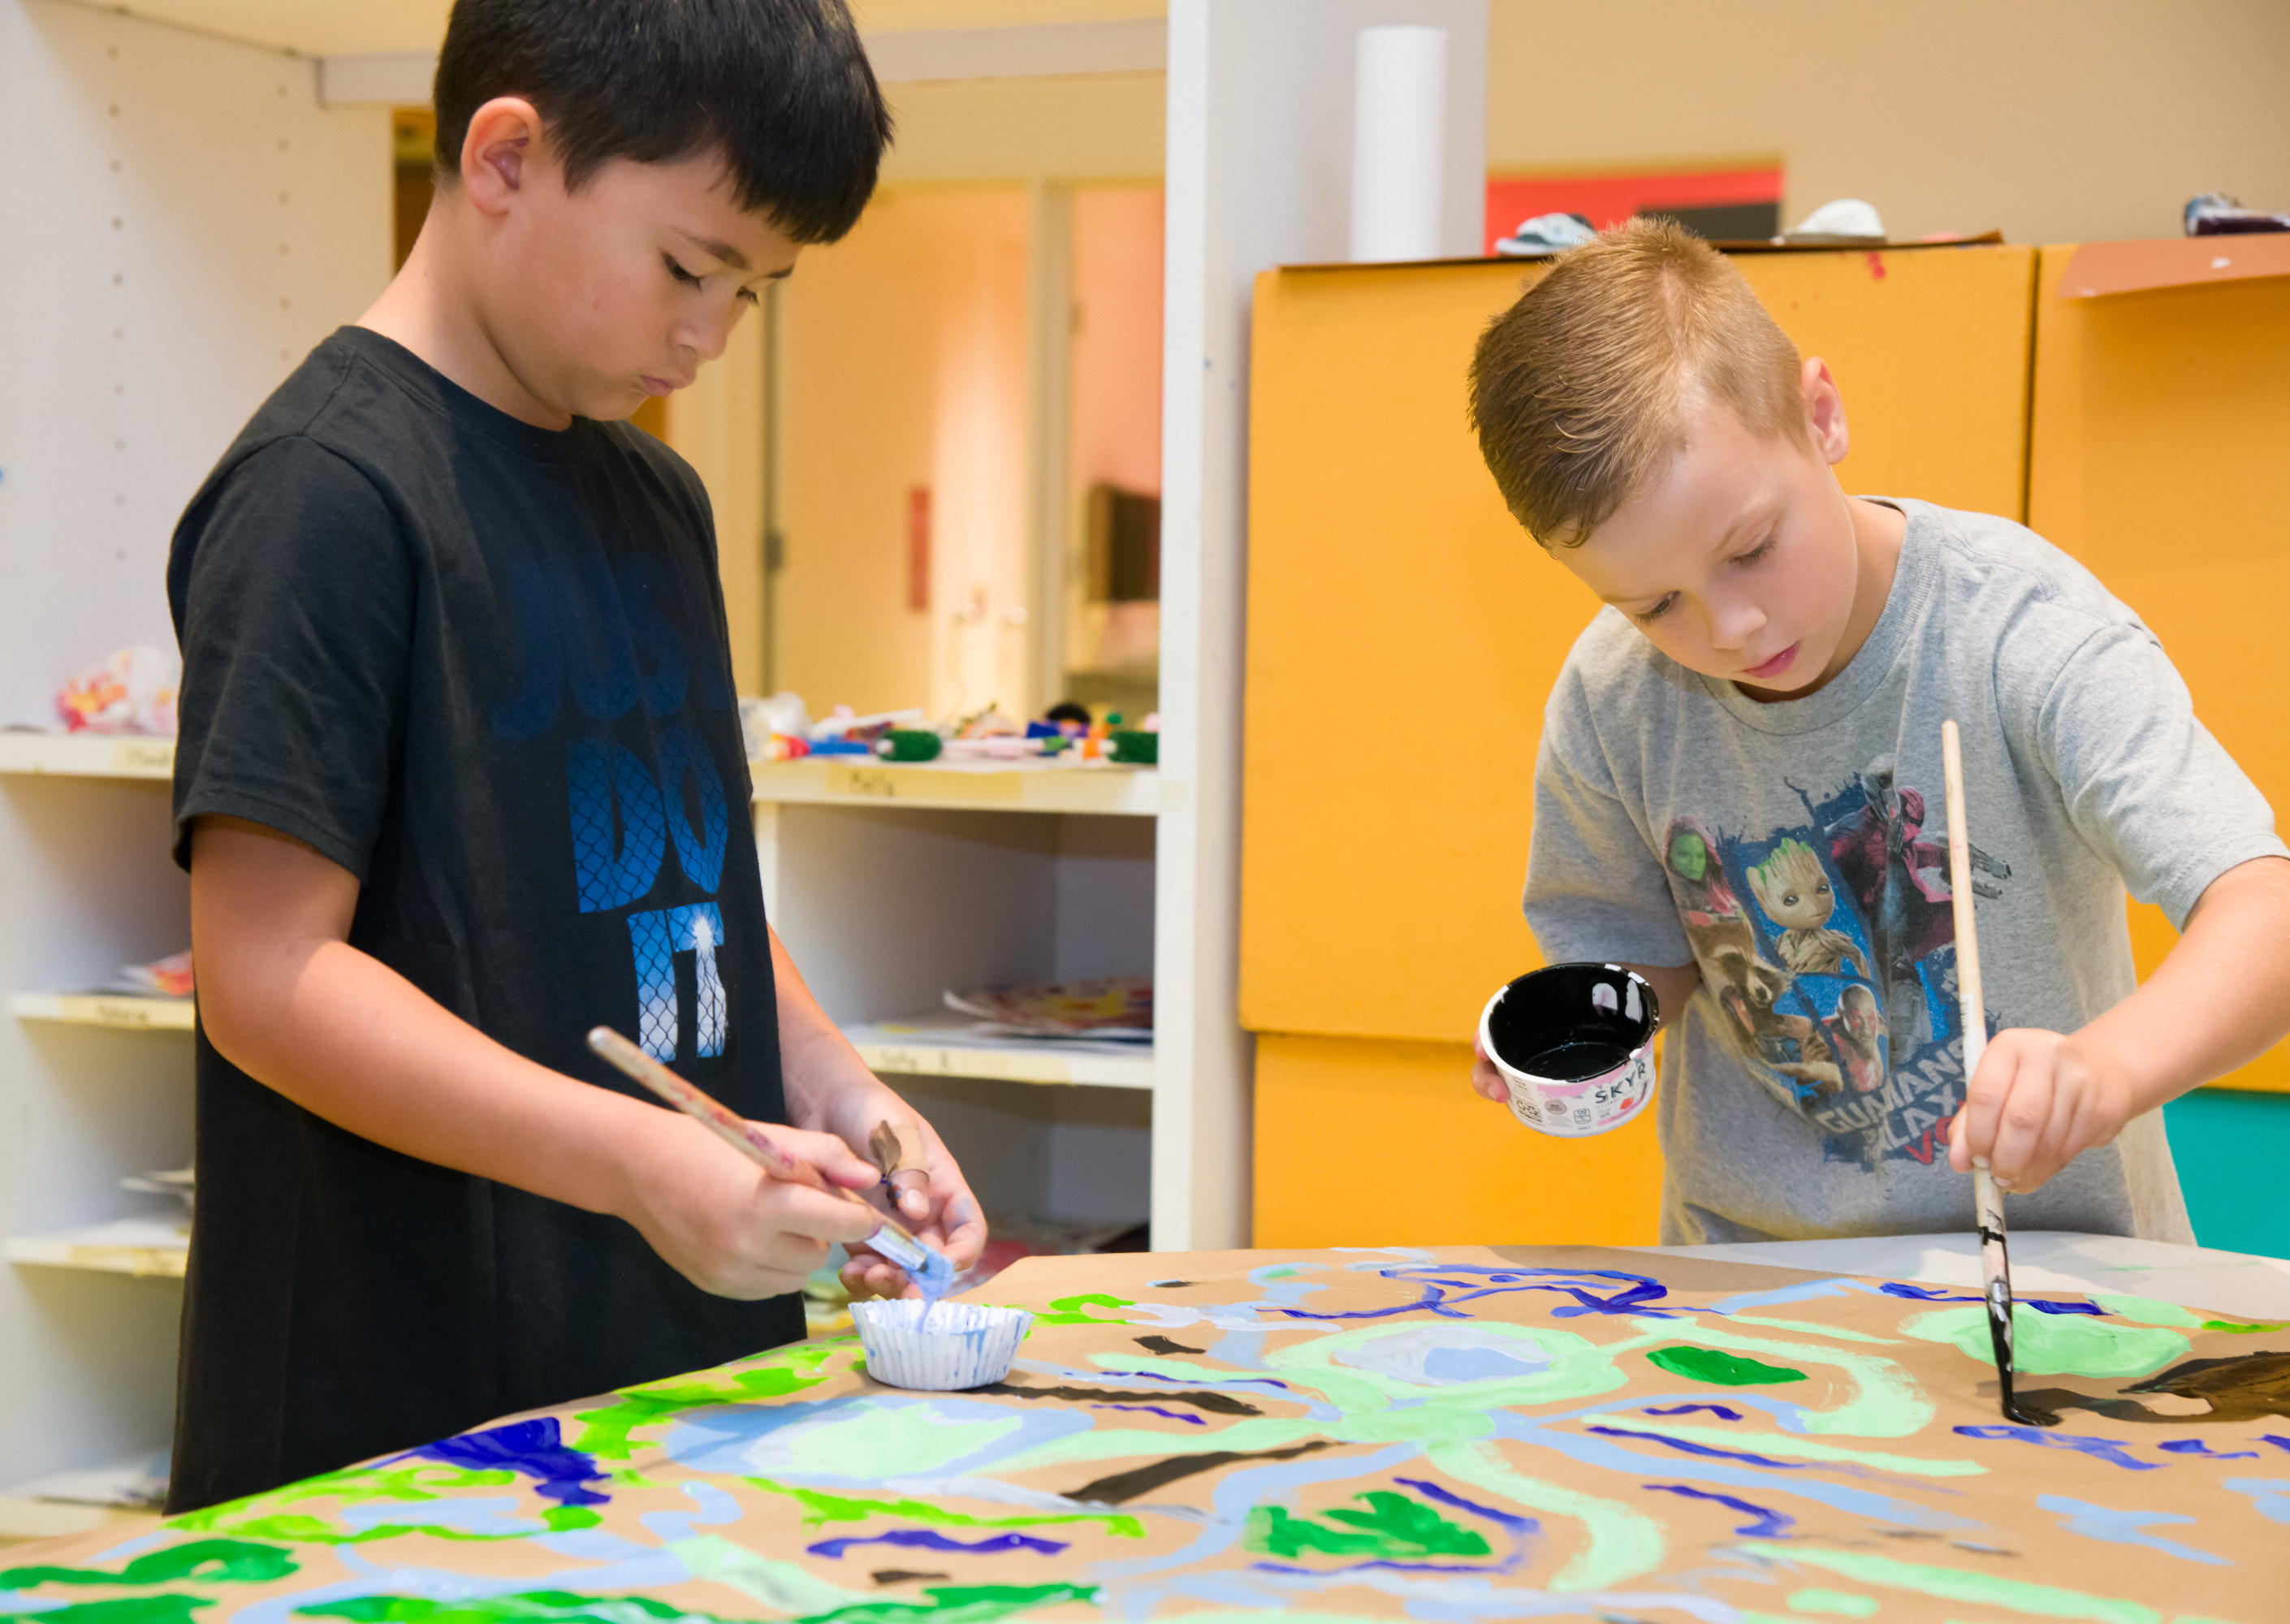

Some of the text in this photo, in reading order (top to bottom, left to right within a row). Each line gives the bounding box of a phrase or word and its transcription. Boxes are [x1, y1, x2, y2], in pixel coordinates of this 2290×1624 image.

[566, 727, 728, 914] DO
[627, 901, 727, 1065] IT
[1595, 1062, 1646, 1104] SKYR
